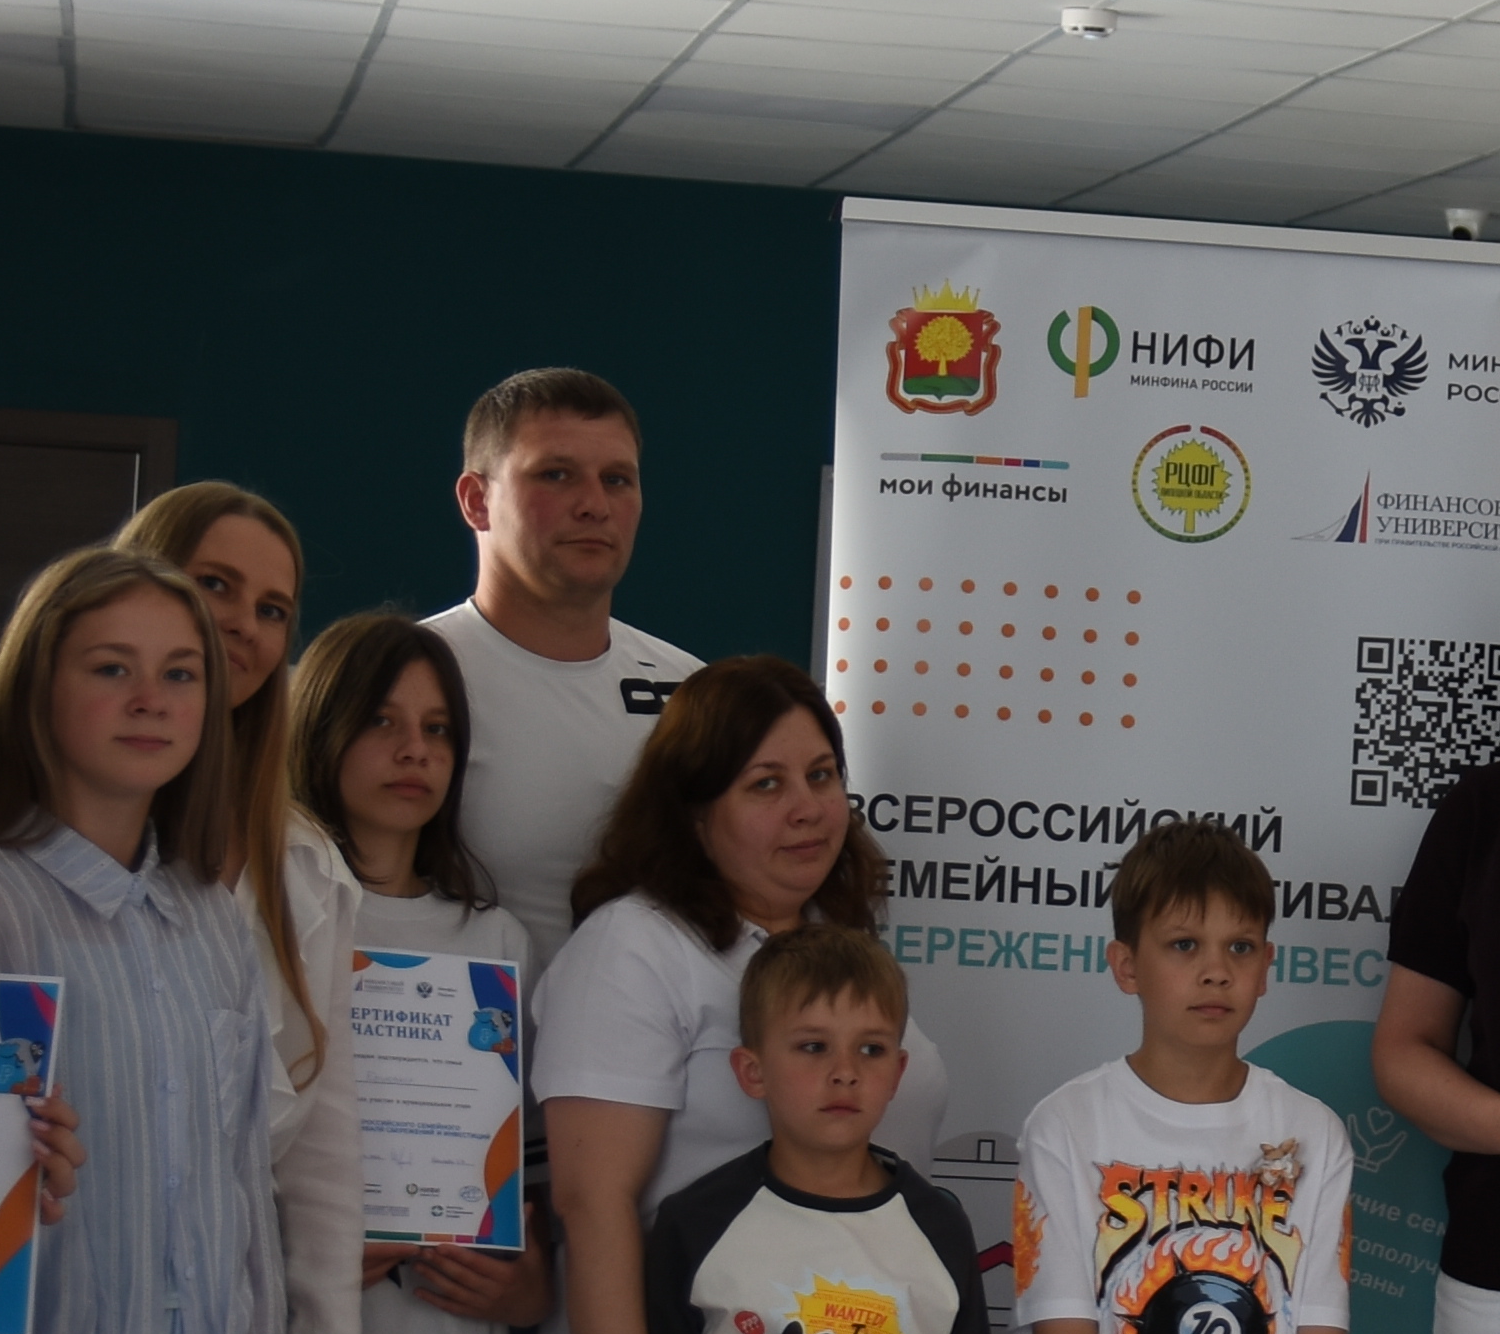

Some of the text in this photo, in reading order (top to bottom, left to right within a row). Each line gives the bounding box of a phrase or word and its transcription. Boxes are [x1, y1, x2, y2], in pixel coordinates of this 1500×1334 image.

[1131, 331, 1256, 372] НИФИ
[1130, 374, 1253, 394] МИНФИНА РОССИИ
[879, 473, 1068, 503] мои финансы
[1164, 461, 1220, 487] РЦФГ
